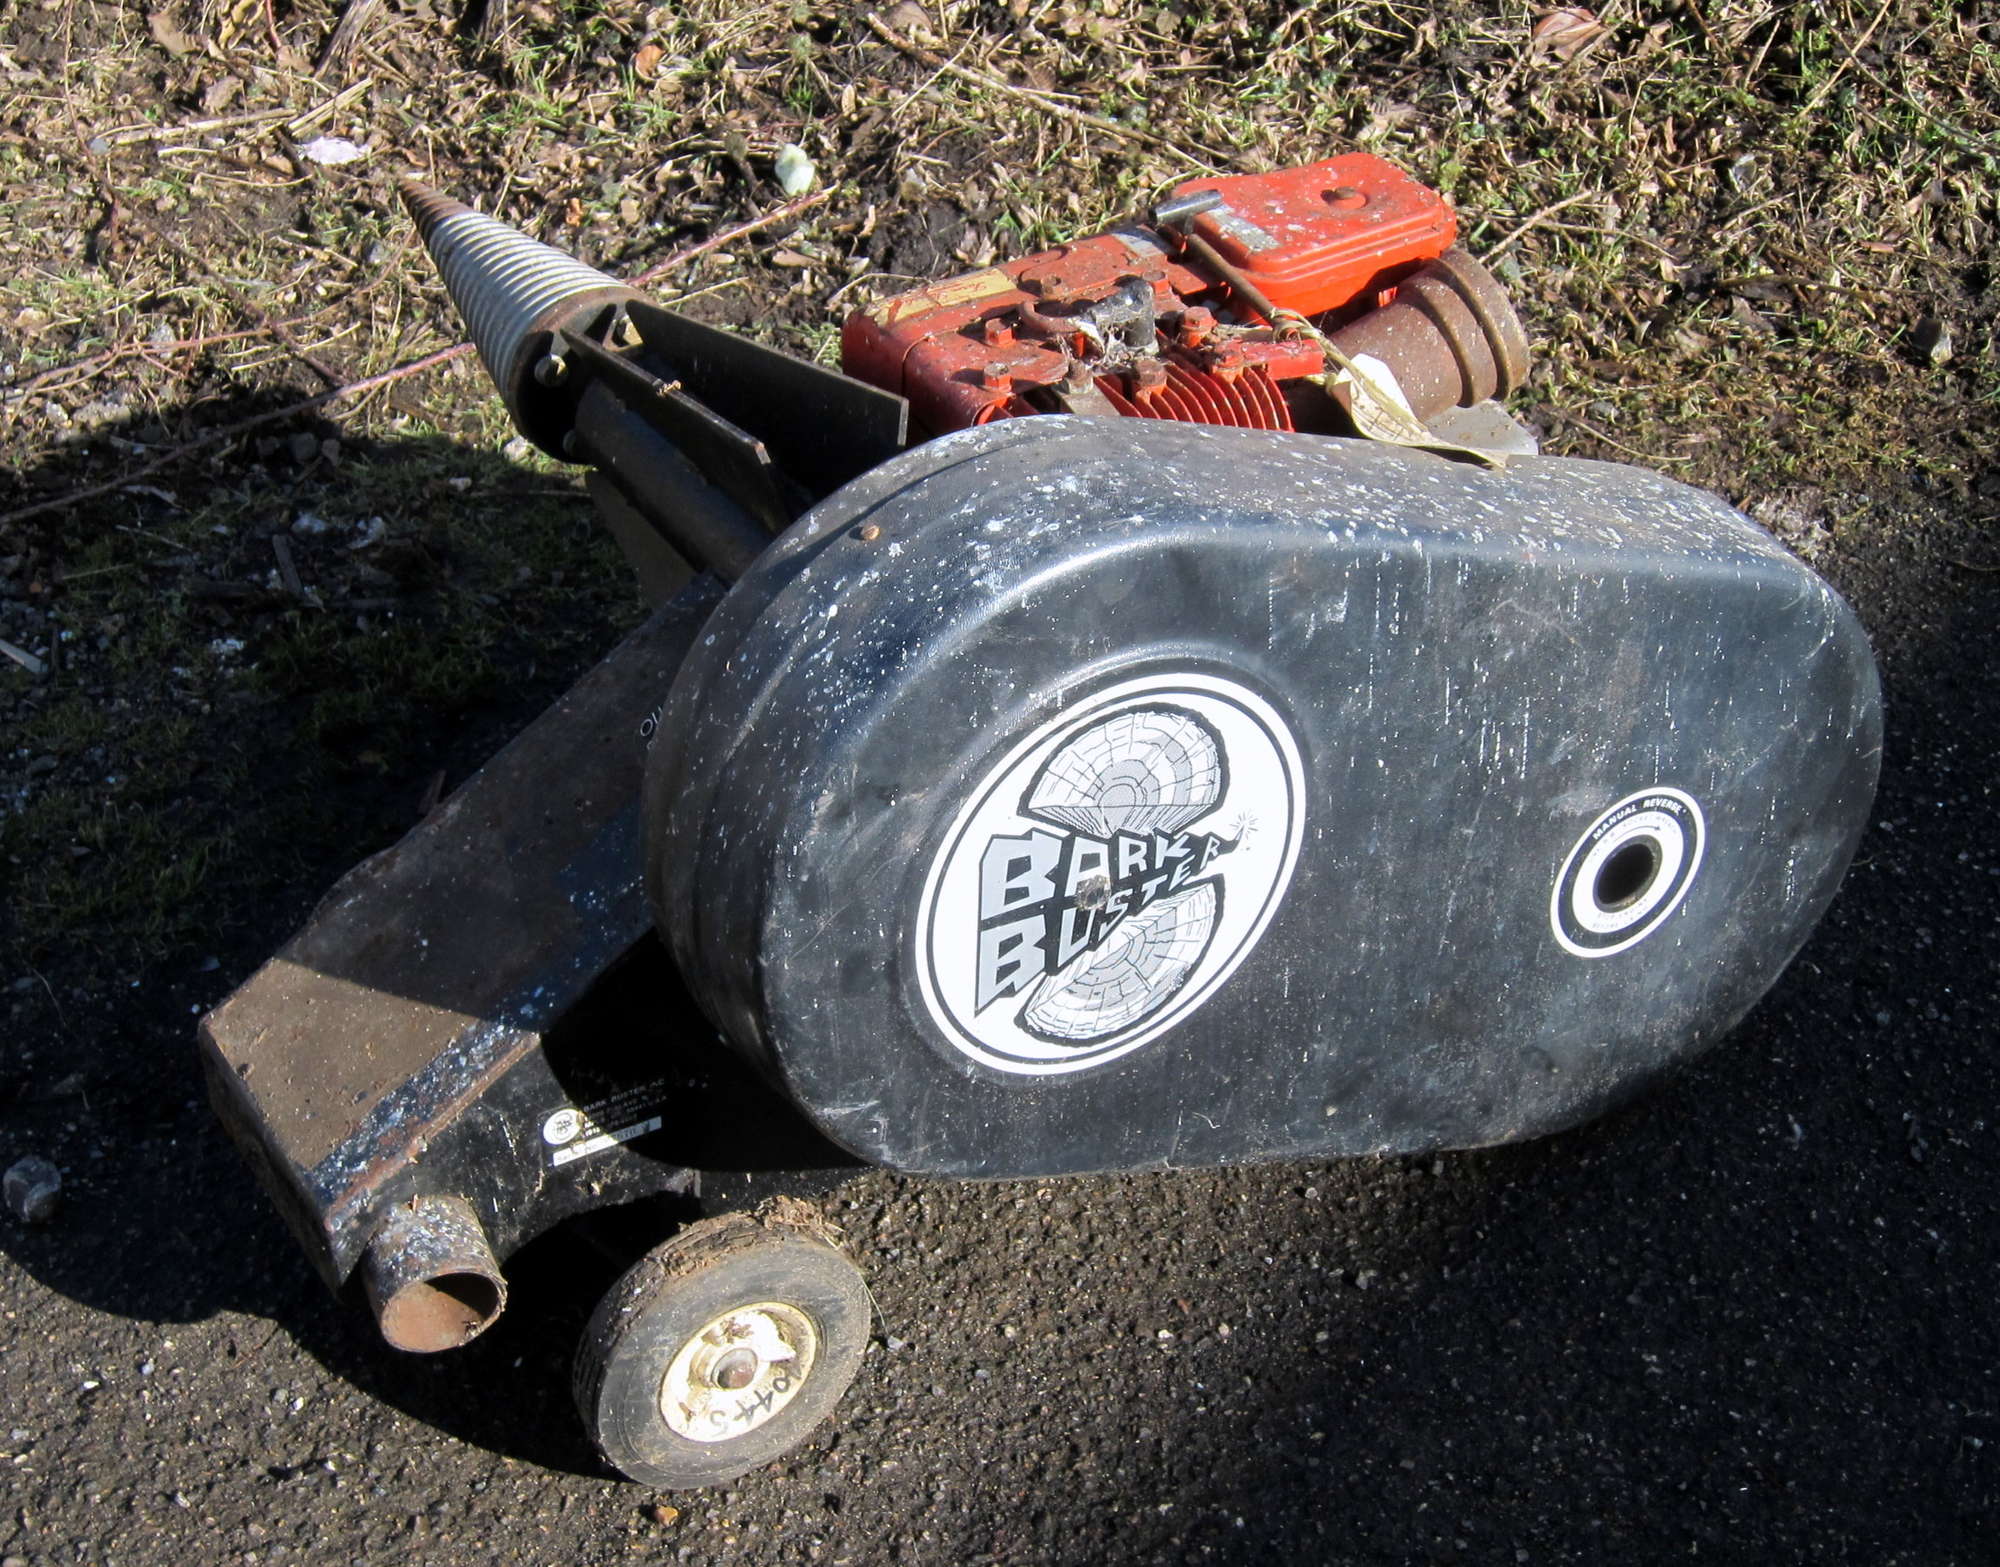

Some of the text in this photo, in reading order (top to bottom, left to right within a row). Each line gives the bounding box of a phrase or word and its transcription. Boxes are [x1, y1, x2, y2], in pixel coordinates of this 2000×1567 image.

[1593, 804, 1637, 840] MANUAL
[1643, 798, 1682, 815] REVERSE
[980, 830, 1193, 921] BARK
[976, 838, 1219, 1014] BUSTER
